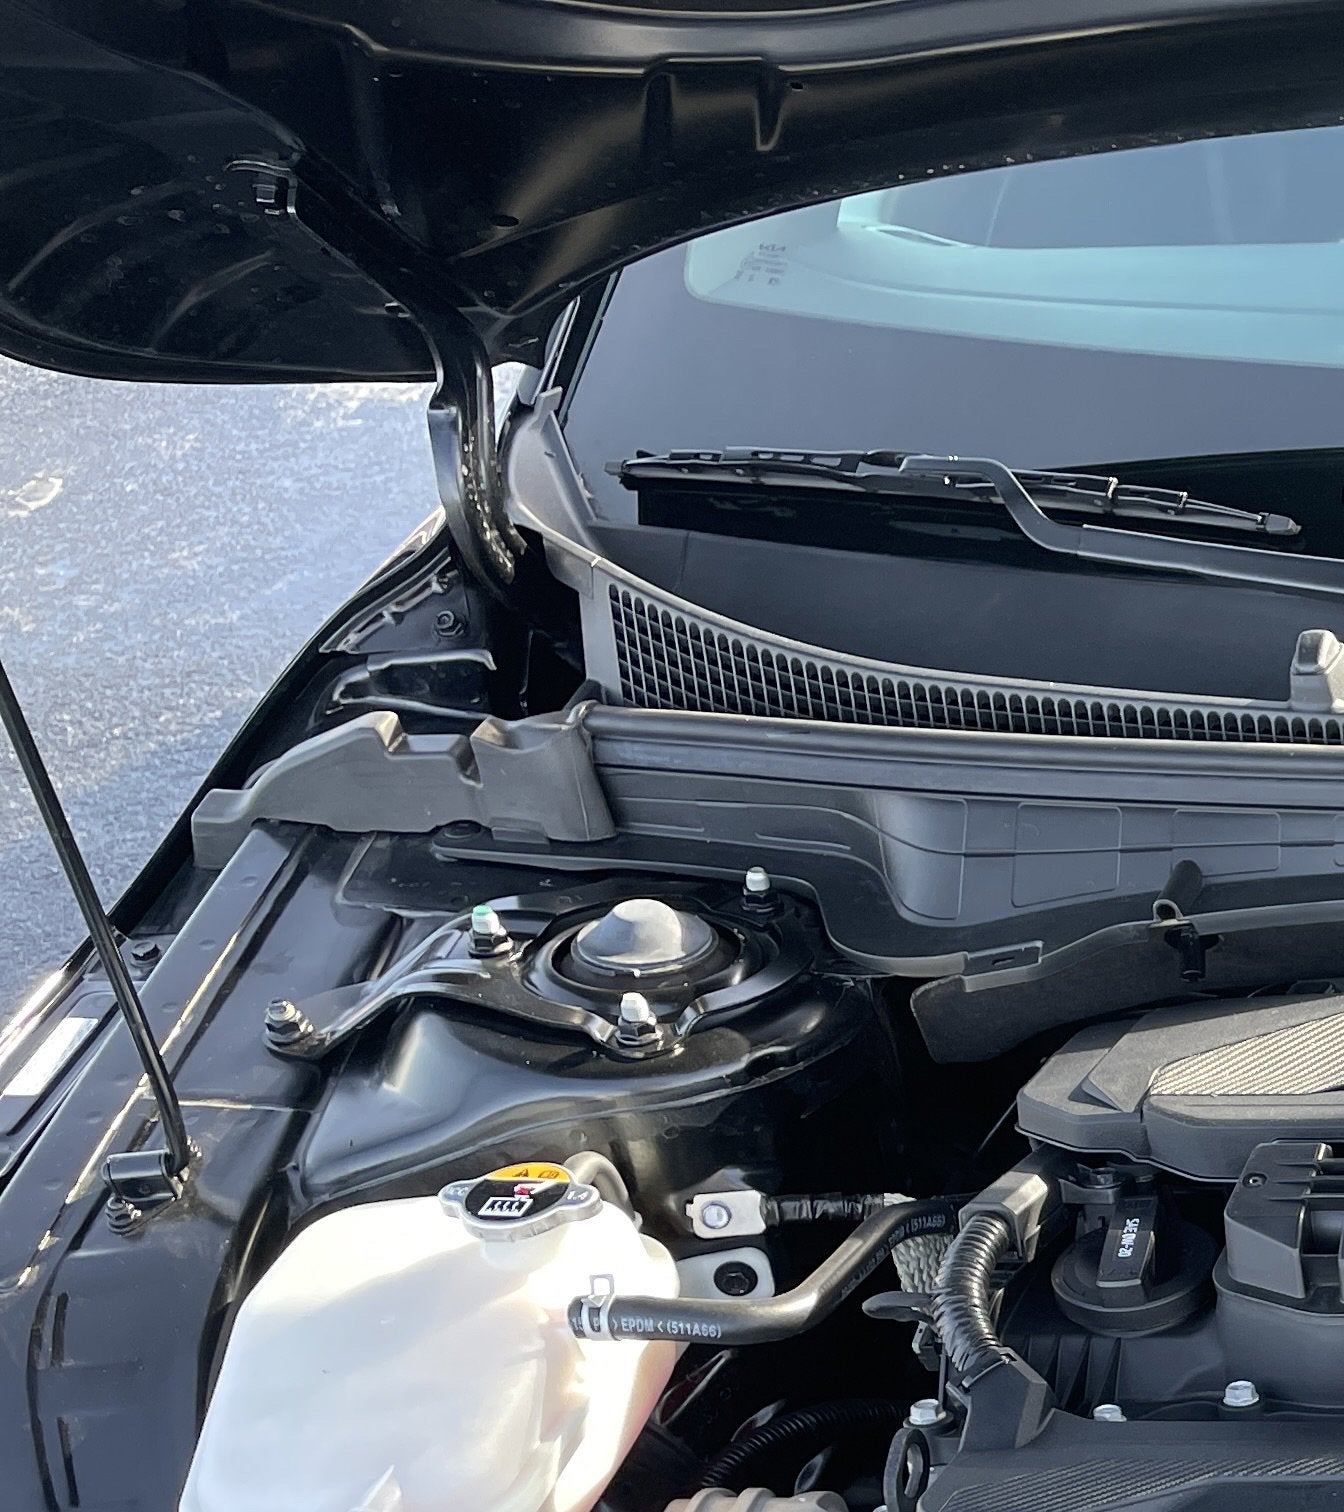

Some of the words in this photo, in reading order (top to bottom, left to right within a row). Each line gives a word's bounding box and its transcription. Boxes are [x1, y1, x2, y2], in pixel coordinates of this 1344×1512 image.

[1122, 1217, 1140, 1233] SAE
[620, 1317, 655, 1334] EPDM
[665, 1320, 722, 1339] (511A66)
